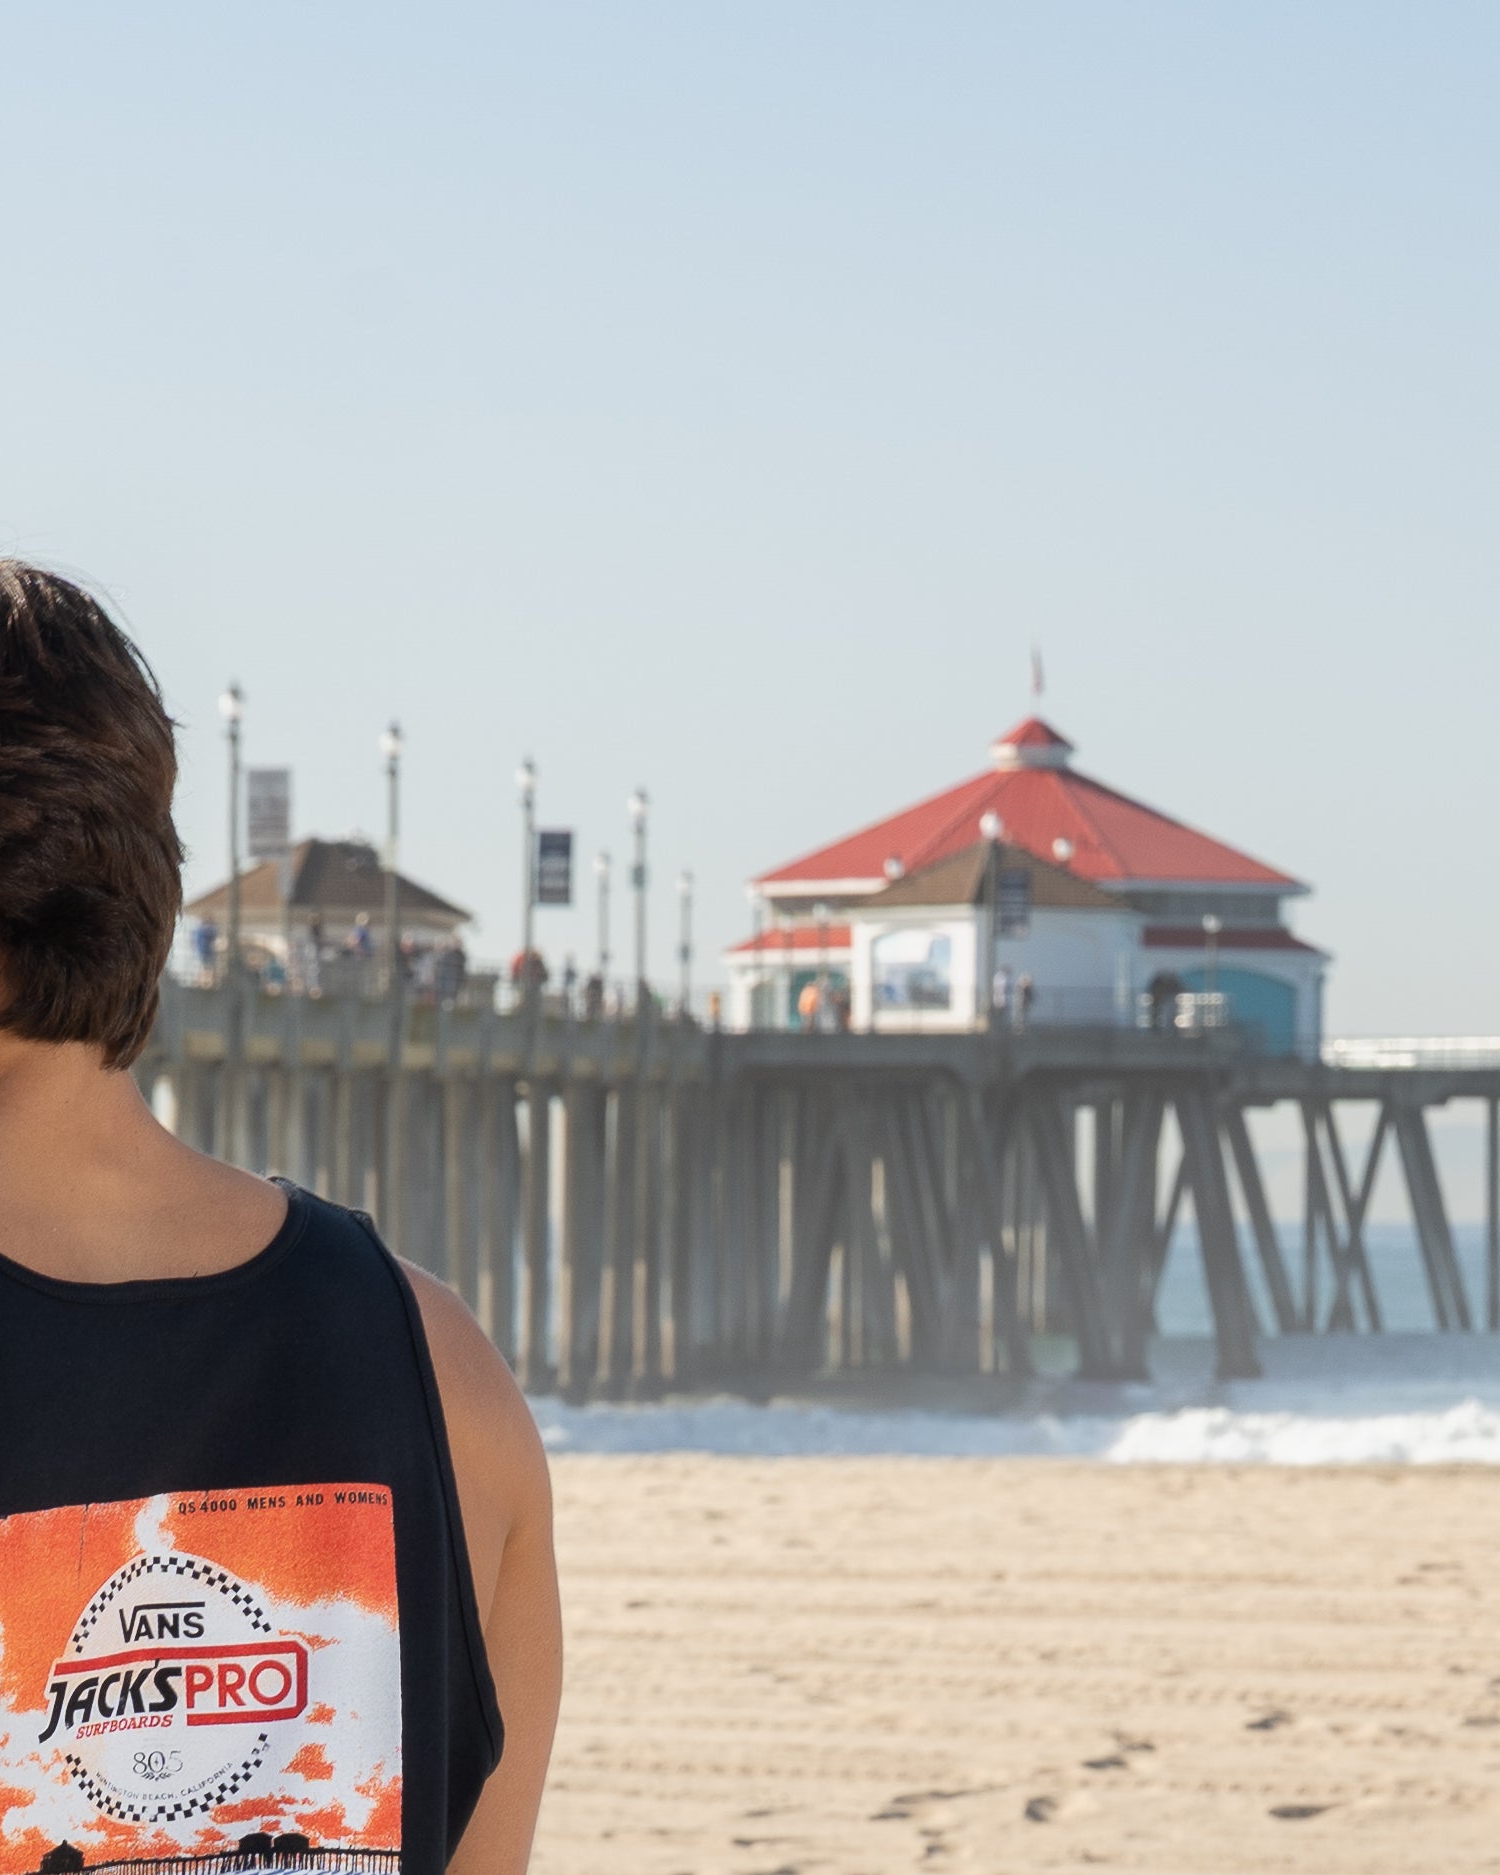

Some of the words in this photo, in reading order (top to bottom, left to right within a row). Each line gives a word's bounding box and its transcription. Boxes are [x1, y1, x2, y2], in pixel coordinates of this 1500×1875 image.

[247, 1496, 286, 1510] MENS
[295, 1493, 324, 1506] AND
[334, 1491, 388, 1506] WOMENS
[119, 1601, 205, 1643] VANS
[38, 1658, 182, 1744] JACK'S
[185, 1659, 292, 1709] PRO
[76, 1714, 174, 1740] SURFBOARDS
[132, 1750, 184, 1775] 805
[180, 1762, 233, 1797] CALIFORNIA
